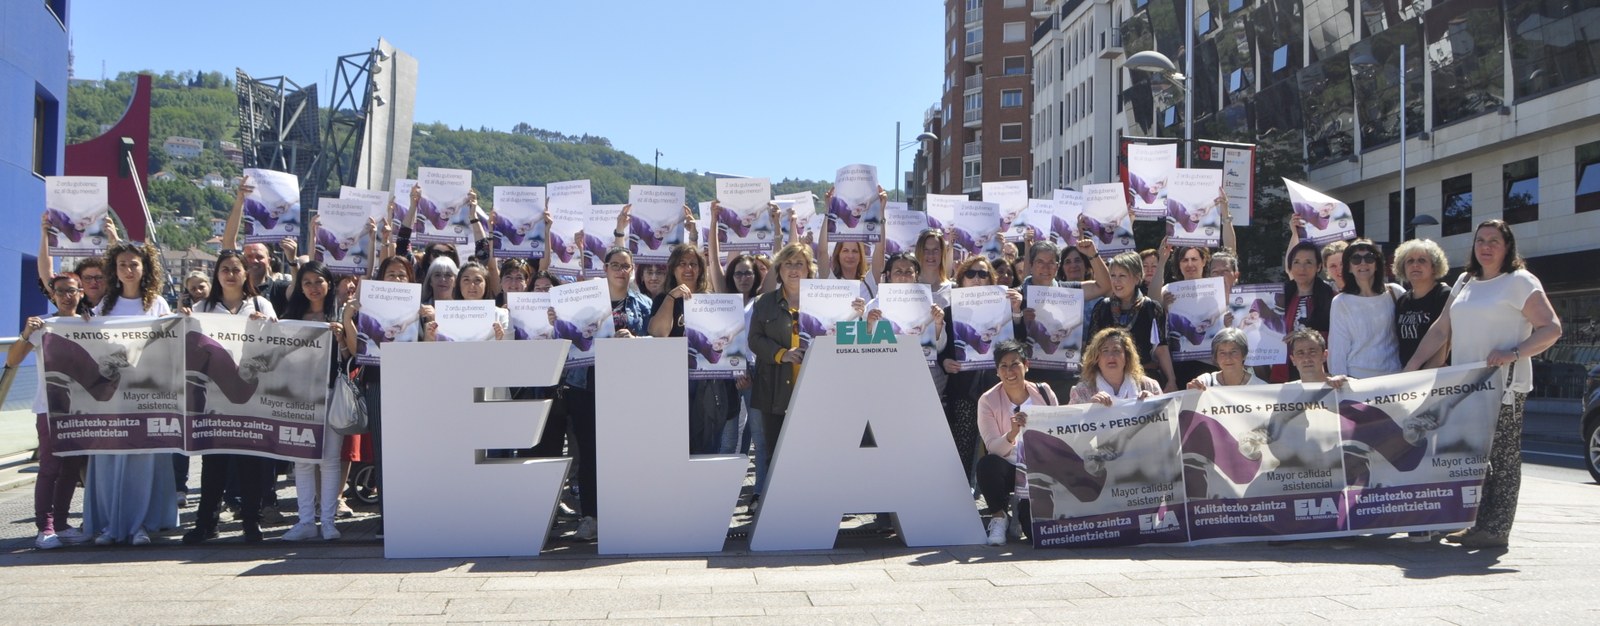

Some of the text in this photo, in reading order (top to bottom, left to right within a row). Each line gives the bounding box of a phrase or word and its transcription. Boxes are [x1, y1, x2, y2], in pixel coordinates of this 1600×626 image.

[73, 332, 110, 340] RATIOS
[122, 331, 178, 339] PERSONAL
[836, 320, 897, 344] ELA
[218, 332, 255, 342] RATIOS
[267, 336, 322, 348] PERSONAL
[124, 392, 148, 402] Mayor
[1375, 392, 1417, 404] RATIOS
[1431, 381, 1495, 397] PERSONAL
[261, 397, 315, 410] Mayor calidad
[1211, 405, 1252, 415] RATIOS
[1266, 401, 1328, 412] PERSONAL
[272, 410, 314, 420] asistencial
[57, 418, 106, 429] Kalitatezko
[147, 418, 182, 433] ELA
[192, 419, 273, 431] Kalitatezko zaintza
[1057, 423, 1097, 435] RATIOS
[1109, 413, 1168, 428] PERSONAL
[57, 429, 128, 439] erresidentzietan
[192, 429, 263, 439] erresidentzietan
[279, 426, 316, 444] ELA
[381, 336, 988, 558] ELA
[1432, 454, 1487, 468] Mayor calid
[1267, 468, 1331, 482] Mayor calidad
[1449, 467, 1483, 477] asisten
[1112, 482, 1173, 497] Mayor calidad
[1283, 479, 1332, 491] asistencial
[1127, 492, 1174, 506] asistencial
[1356, 488, 1453, 504] Kalitatezko zaintza
[1194, 501, 1286, 514] Kalitatezko zaintza
[1294, 498, 1339, 516] ELA
[1357, 502, 1440, 515] erresidentzietan
[1040, 517, 1131, 535] Kalitatezko zaintza
[1139, 511, 1179, 530] ELA
[1195, 514, 1275, 526] erresidentzietan
[1041, 531, 1120, 545] erresidentzietan
